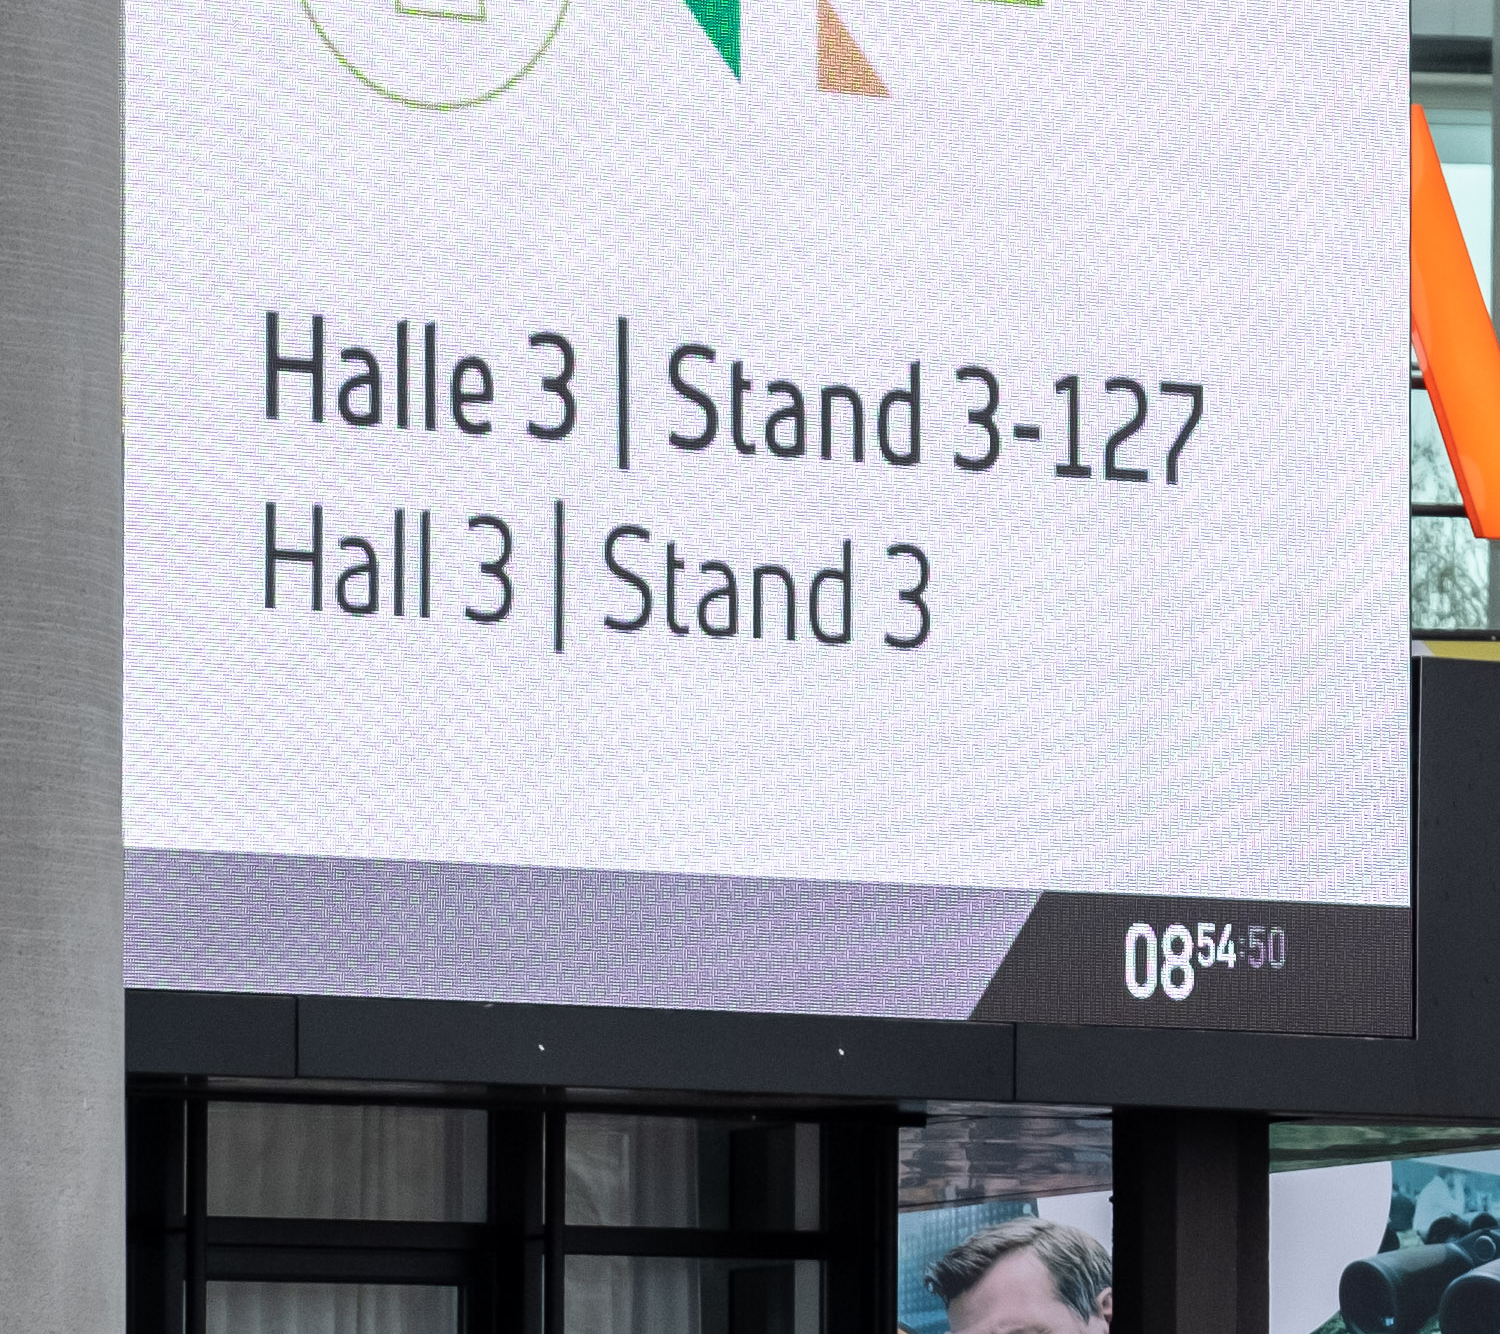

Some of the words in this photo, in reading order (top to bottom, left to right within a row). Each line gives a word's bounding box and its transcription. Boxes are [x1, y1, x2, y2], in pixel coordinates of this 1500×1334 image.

[266, 311, 495, 436] Halle
[527, 332, 577, 442] 3
[668, 343, 922, 468] Stand
[954, 365, 1206, 485] 3-127
[265, 503, 431, 618] Hall
[465, 514, 514, 625] 3
[604, 524, 853, 647] Stand
[885, 543, 932, 651] 3
